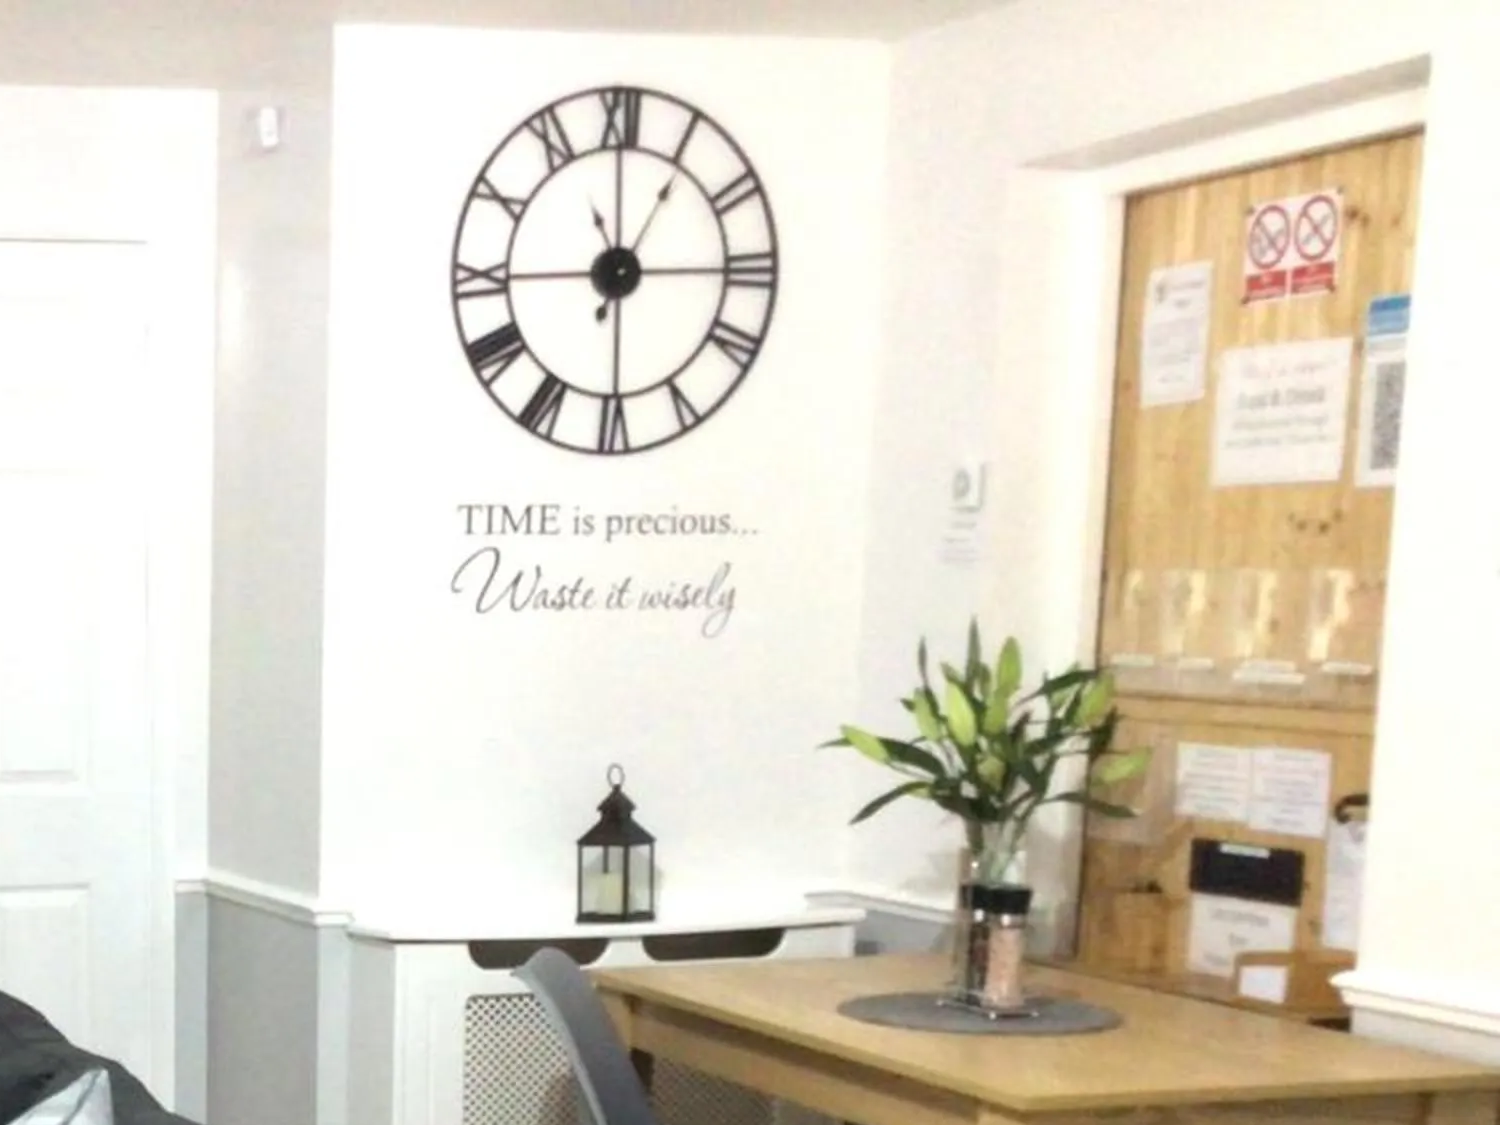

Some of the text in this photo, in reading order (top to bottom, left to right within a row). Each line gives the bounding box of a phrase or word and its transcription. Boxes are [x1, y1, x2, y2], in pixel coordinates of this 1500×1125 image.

[457, 504, 758, 543] TIME is precious...
[451, 546, 736, 639] Waste it wisely
